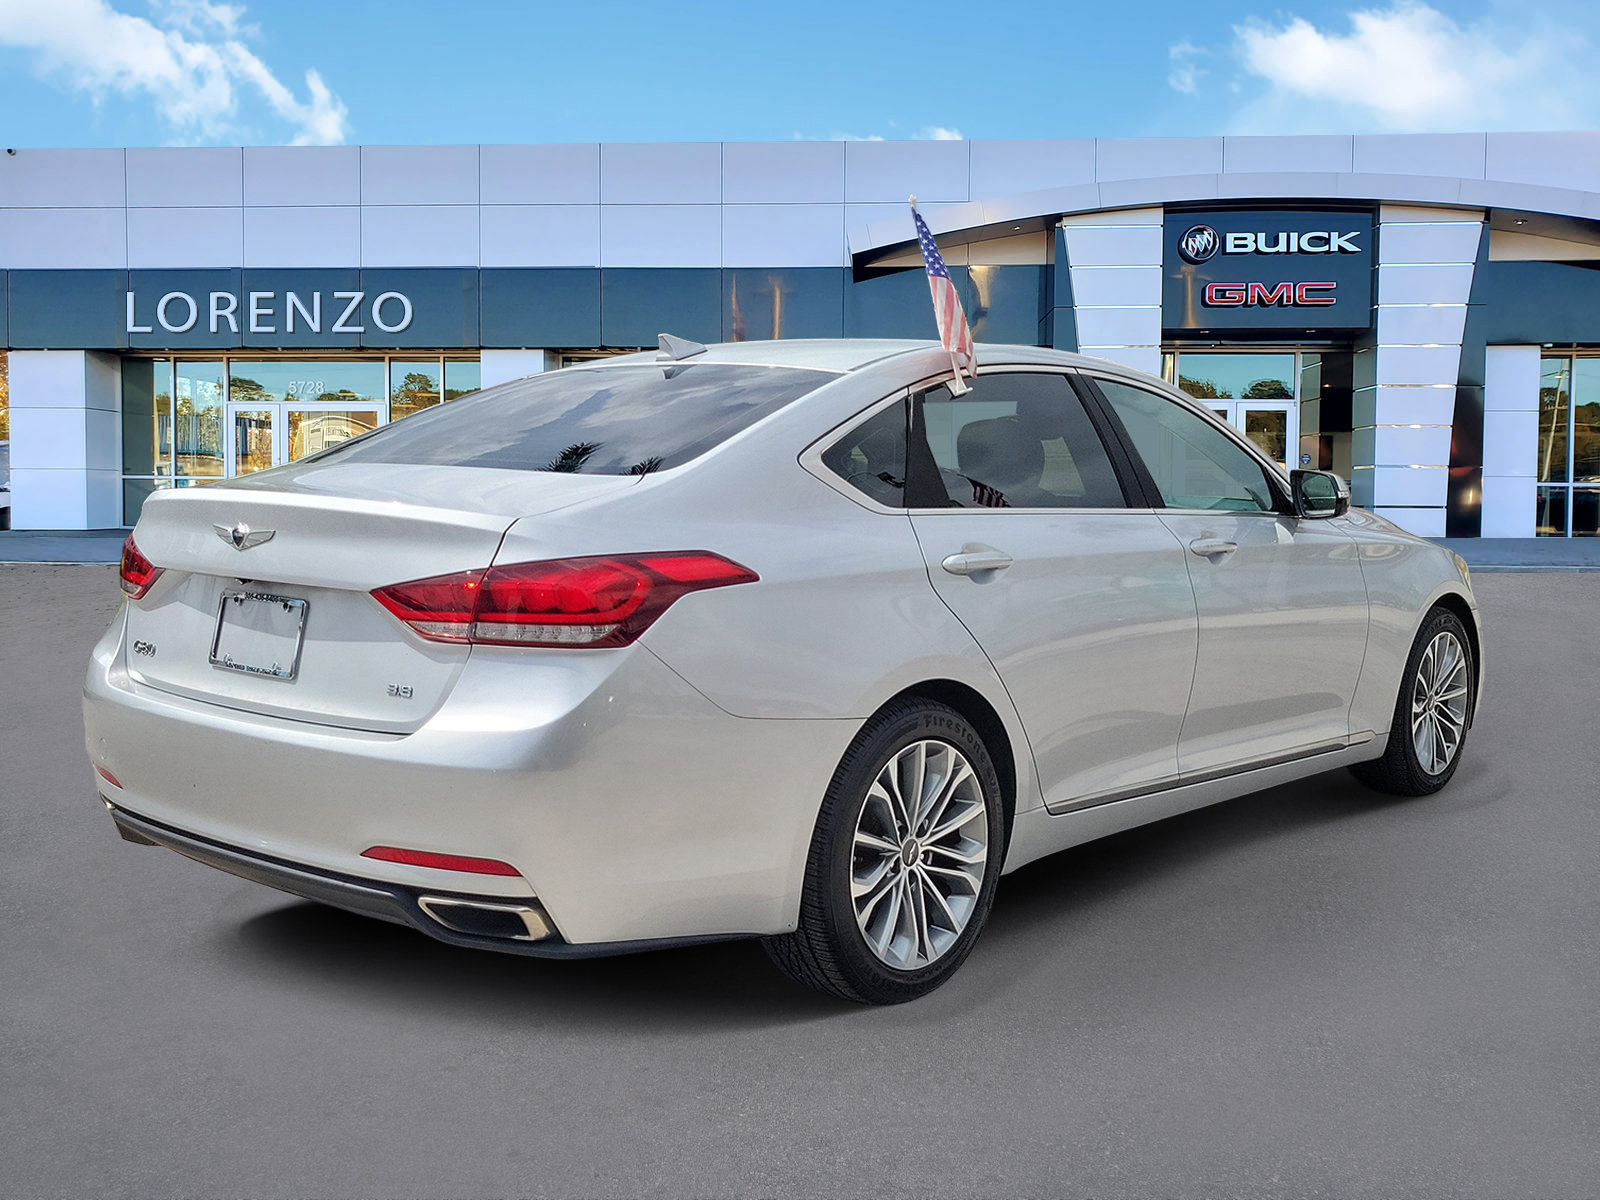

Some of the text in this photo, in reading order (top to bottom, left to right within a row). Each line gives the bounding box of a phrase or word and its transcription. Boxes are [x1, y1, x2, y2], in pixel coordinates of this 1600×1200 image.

[1226, 232, 1361, 254] BUICK
[1205, 282, 1337, 306] GMC
[126, 291, 413, 333] LORENZO
[288, 381, 324, 394] 5728
[924, 714, 987, 762] Firestone
